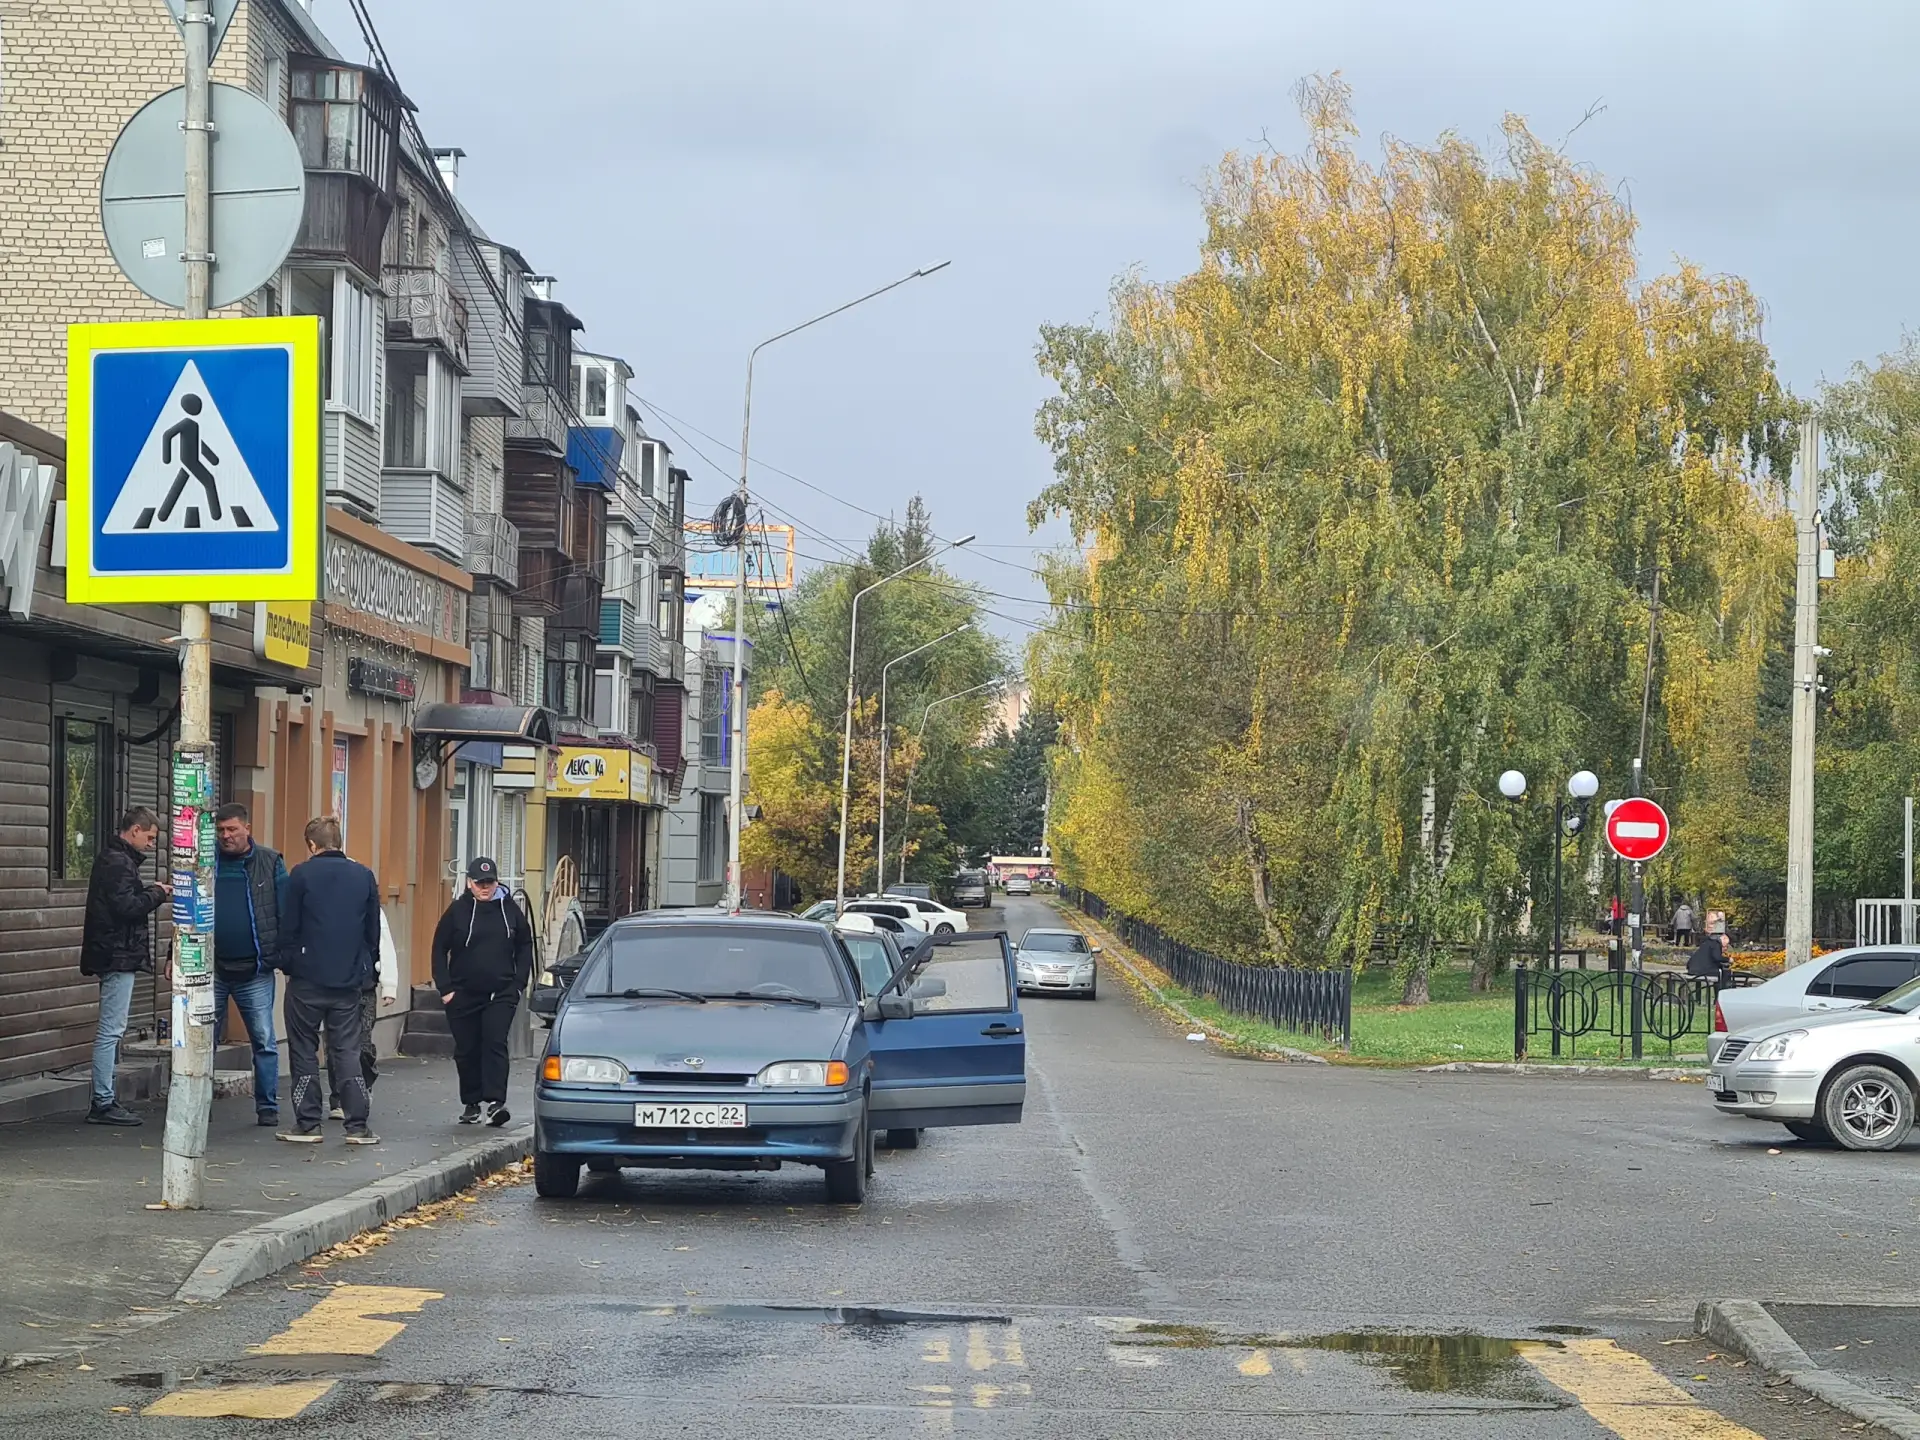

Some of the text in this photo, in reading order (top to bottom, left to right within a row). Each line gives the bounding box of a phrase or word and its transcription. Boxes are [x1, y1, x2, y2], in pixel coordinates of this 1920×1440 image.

[325, 539, 346, 594] АФЕ
[414, 576, 432, 625] БАР
[265, 611, 309, 649] телефонов
[642, 1106, 739, 1125] М712СС 22
